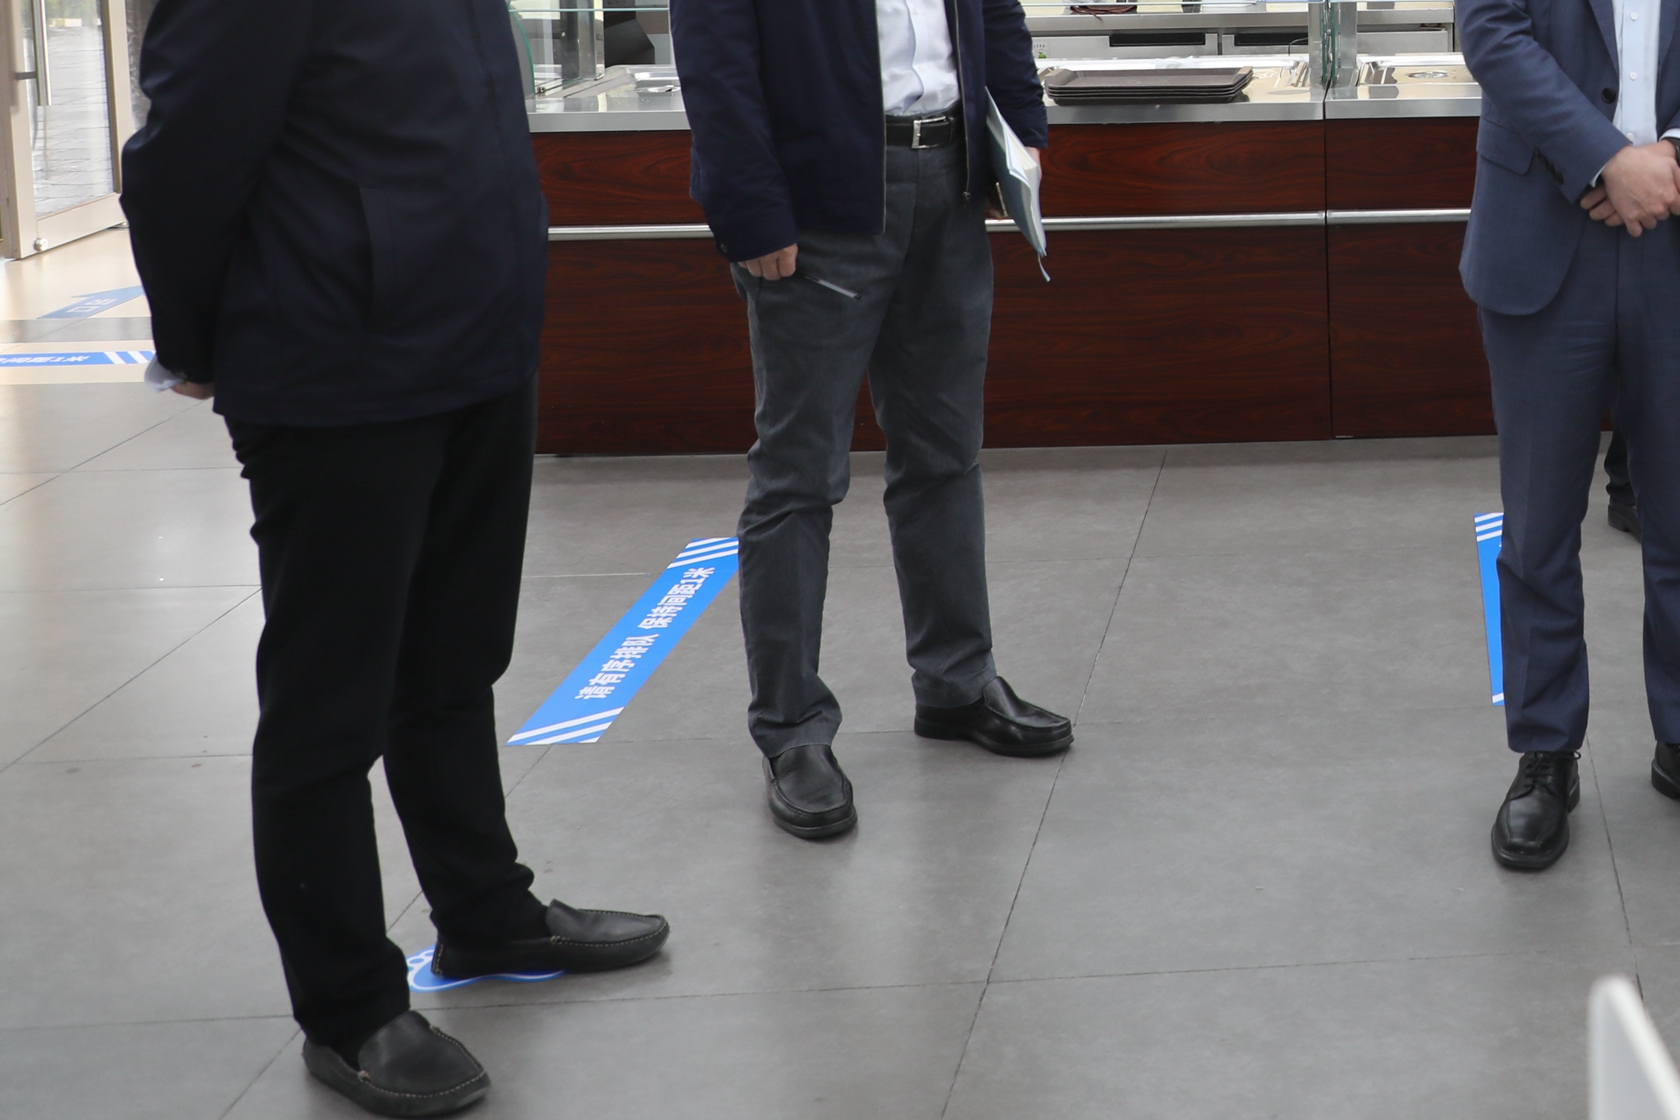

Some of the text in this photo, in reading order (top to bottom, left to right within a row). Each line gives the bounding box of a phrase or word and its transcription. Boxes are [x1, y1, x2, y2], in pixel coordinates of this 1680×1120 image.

[574, 566, 716, 700] 请有序排队 保持间距1米
